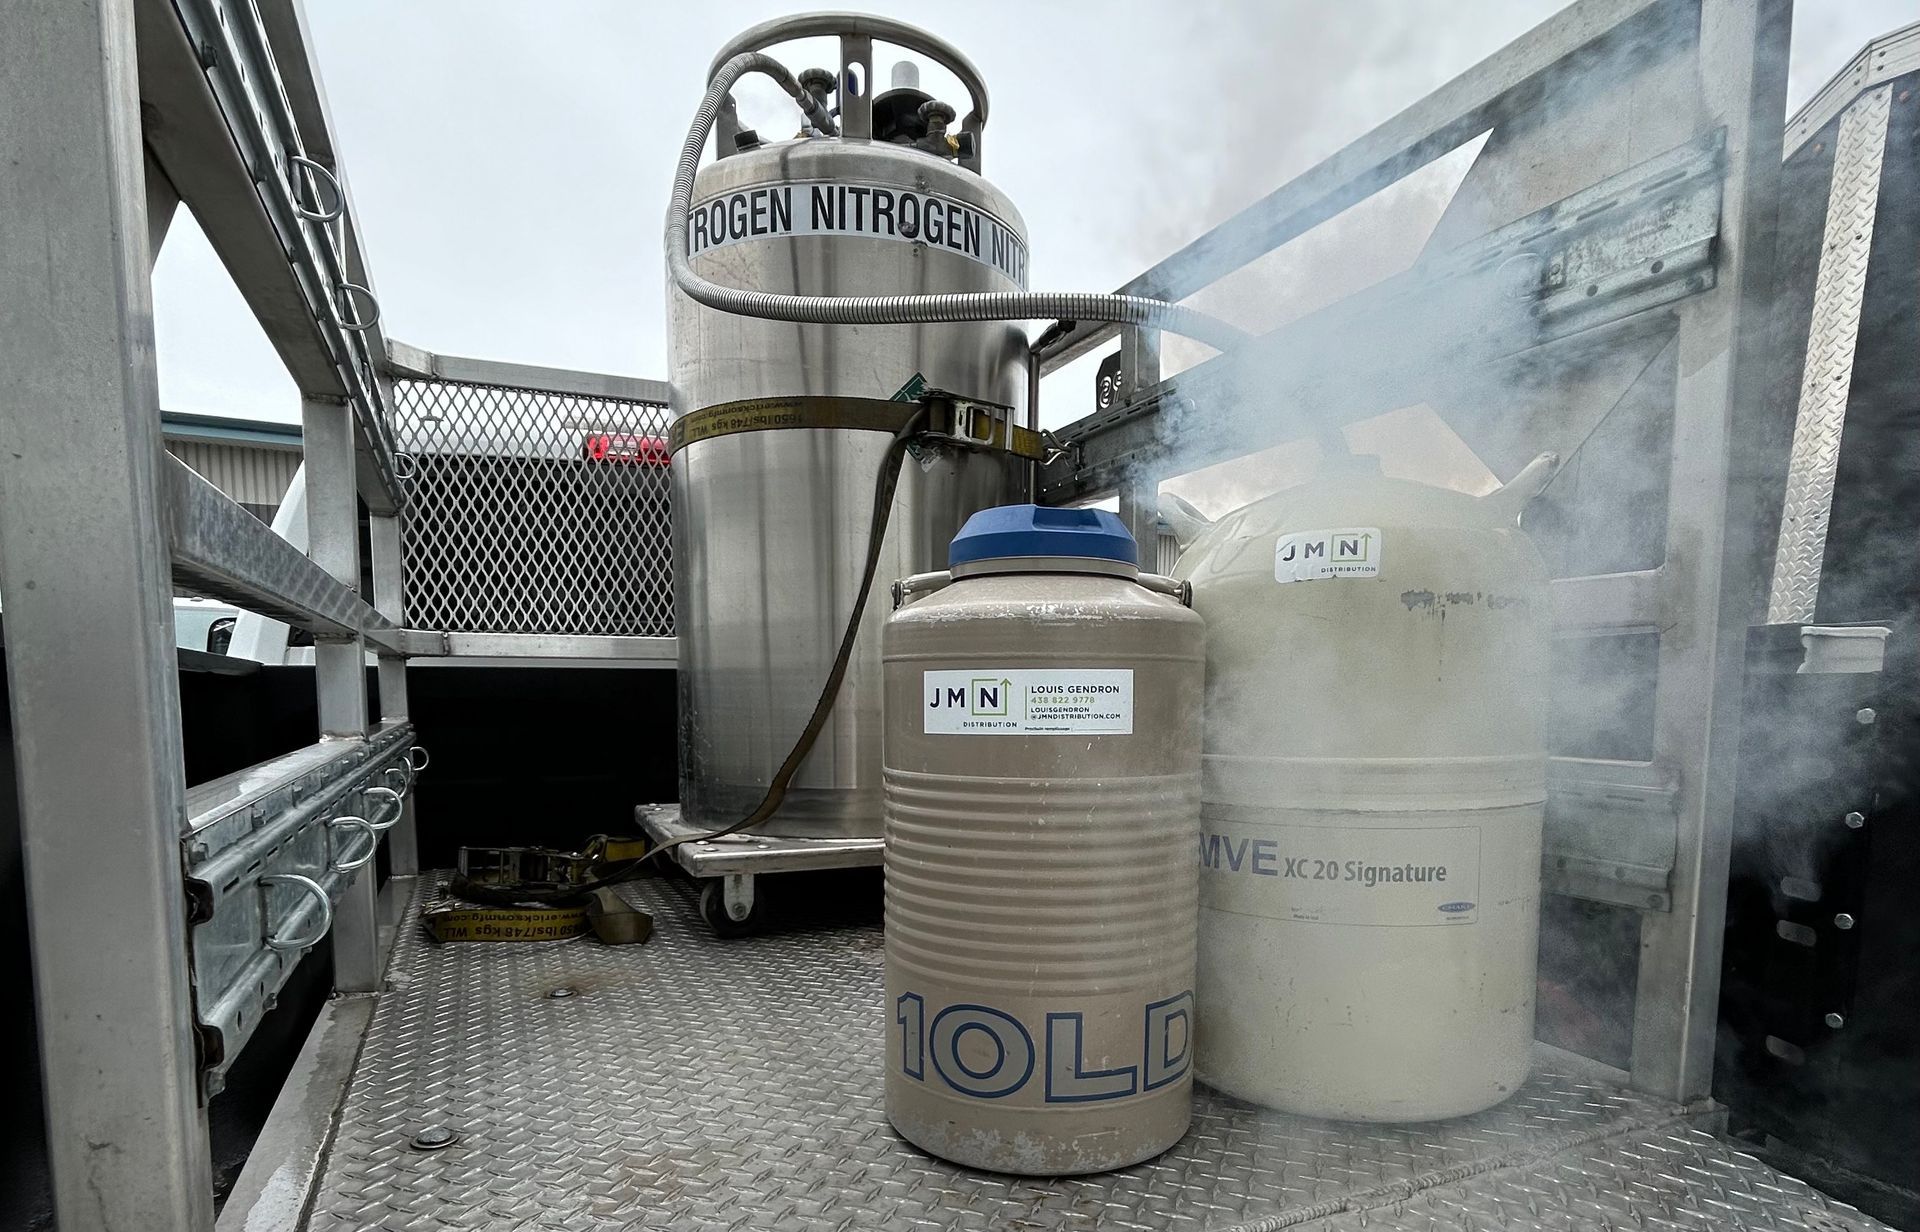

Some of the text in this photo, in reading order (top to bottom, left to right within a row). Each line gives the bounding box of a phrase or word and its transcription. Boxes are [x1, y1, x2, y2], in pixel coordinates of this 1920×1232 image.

[811, 185, 980, 257] NITROGEN
[712, 418, 729, 431] kgs
[731, 415, 771, 428] lbs/748
[692, 427, 708, 438] WLL
[1283, 540, 1358, 562] JMN
[1031, 685, 1120, 694] LOUIS GENDRON
[930, 688, 998, 708] JMN
[1031, 696, 1095, 704] 438 822 9778
[1199, 831, 1447, 887] MVE XC 20 Signature
[475, 924, 501, 937] kgs
